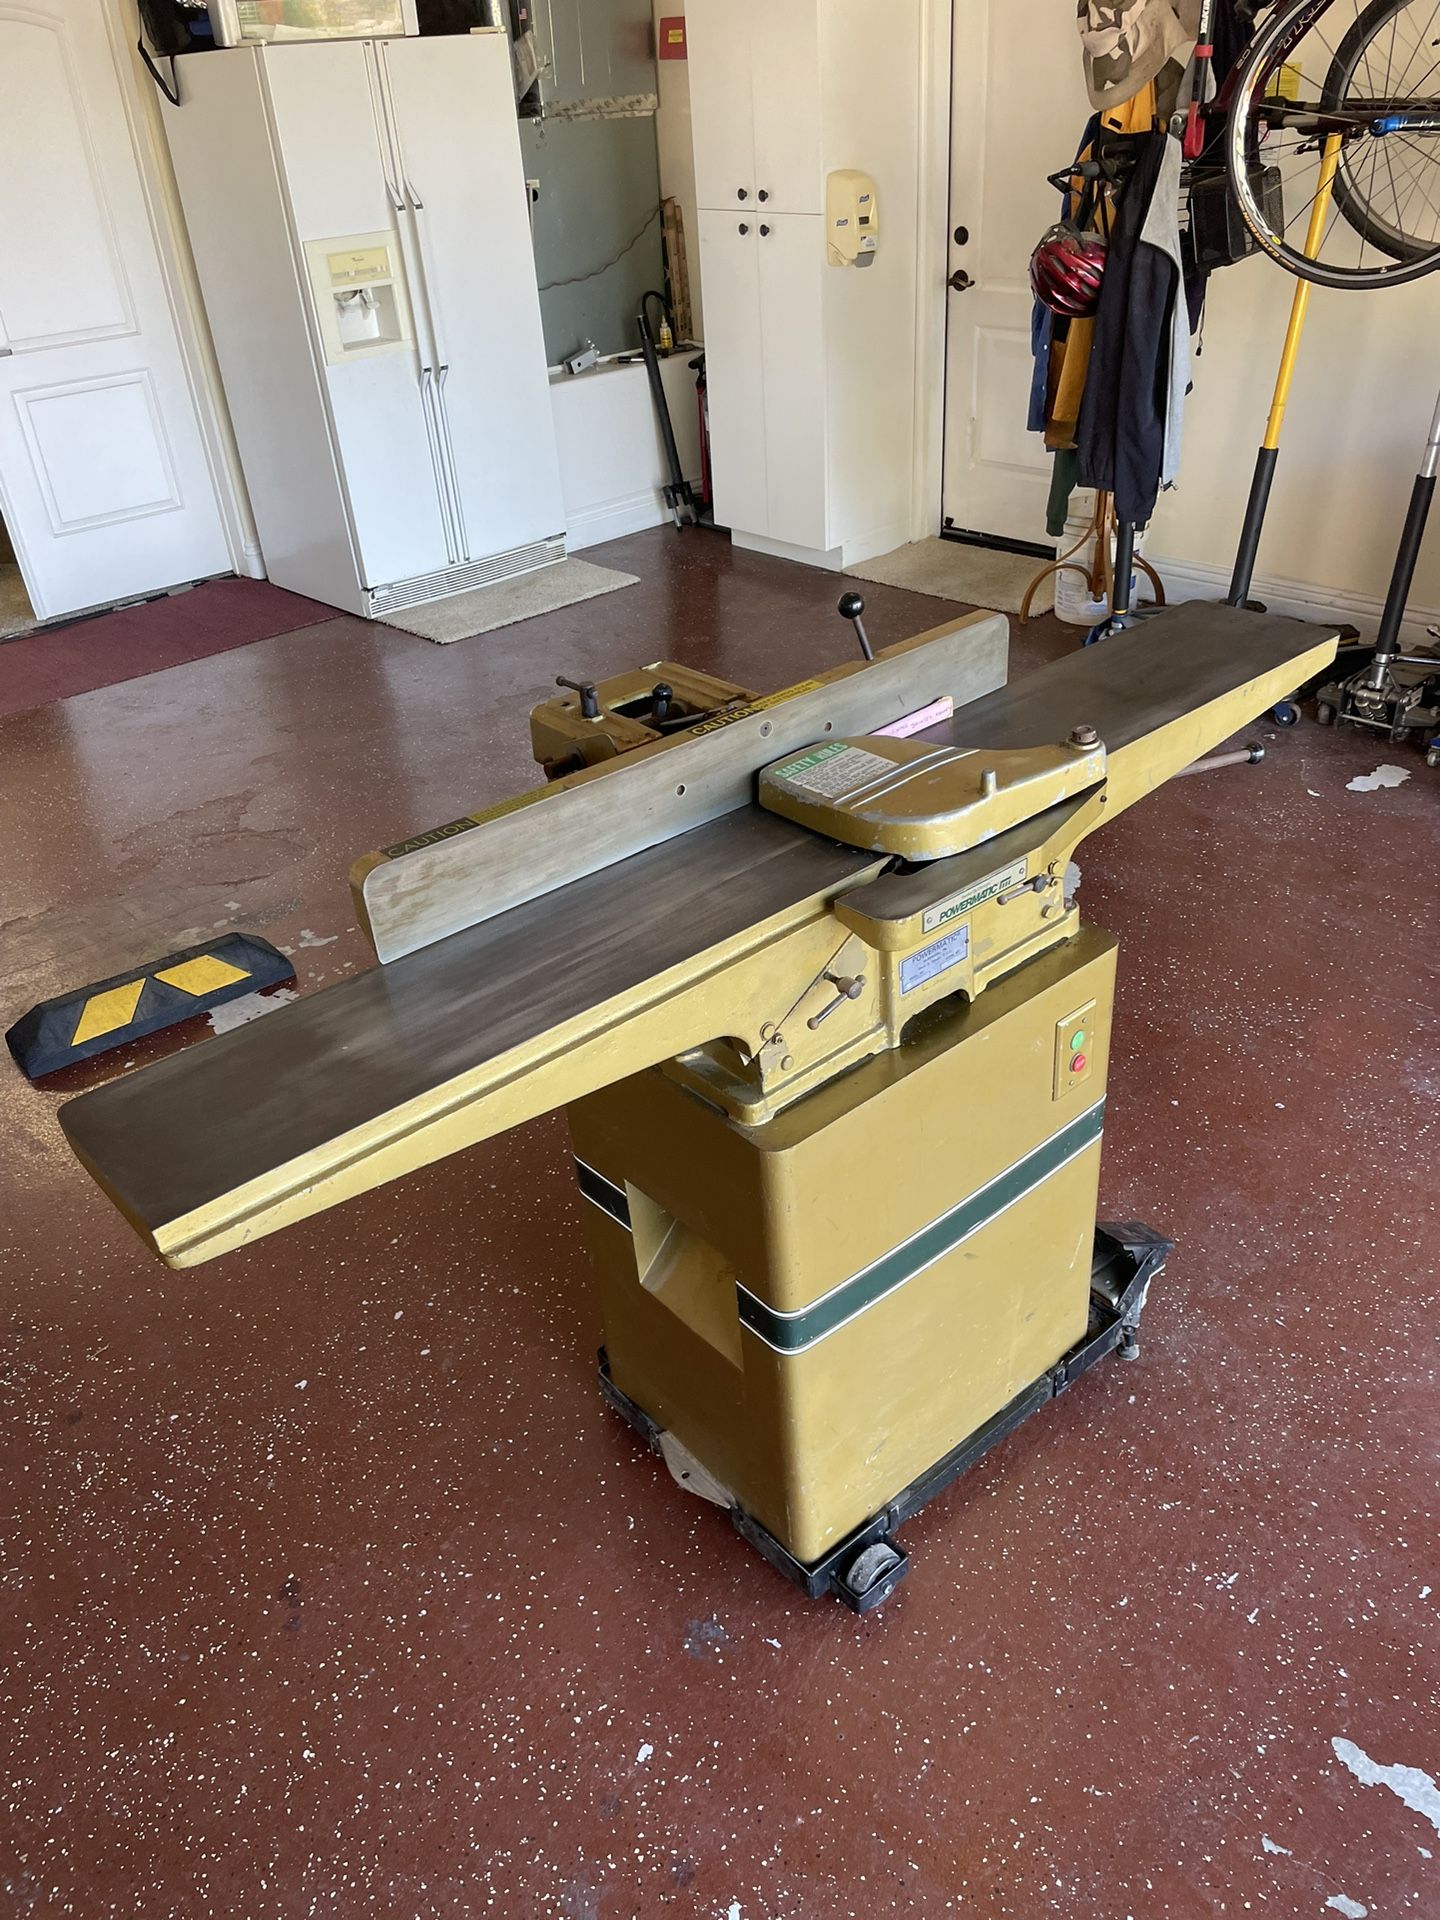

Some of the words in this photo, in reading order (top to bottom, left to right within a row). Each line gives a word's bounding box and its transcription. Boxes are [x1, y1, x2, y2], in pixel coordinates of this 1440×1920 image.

[691, 704, 761, 736] CAUTION
[775, 752, 817, 779] SAFETY
[387, 818, 475, 858] CAUTION
[939, 883, 998, 922] POWERMATIC
